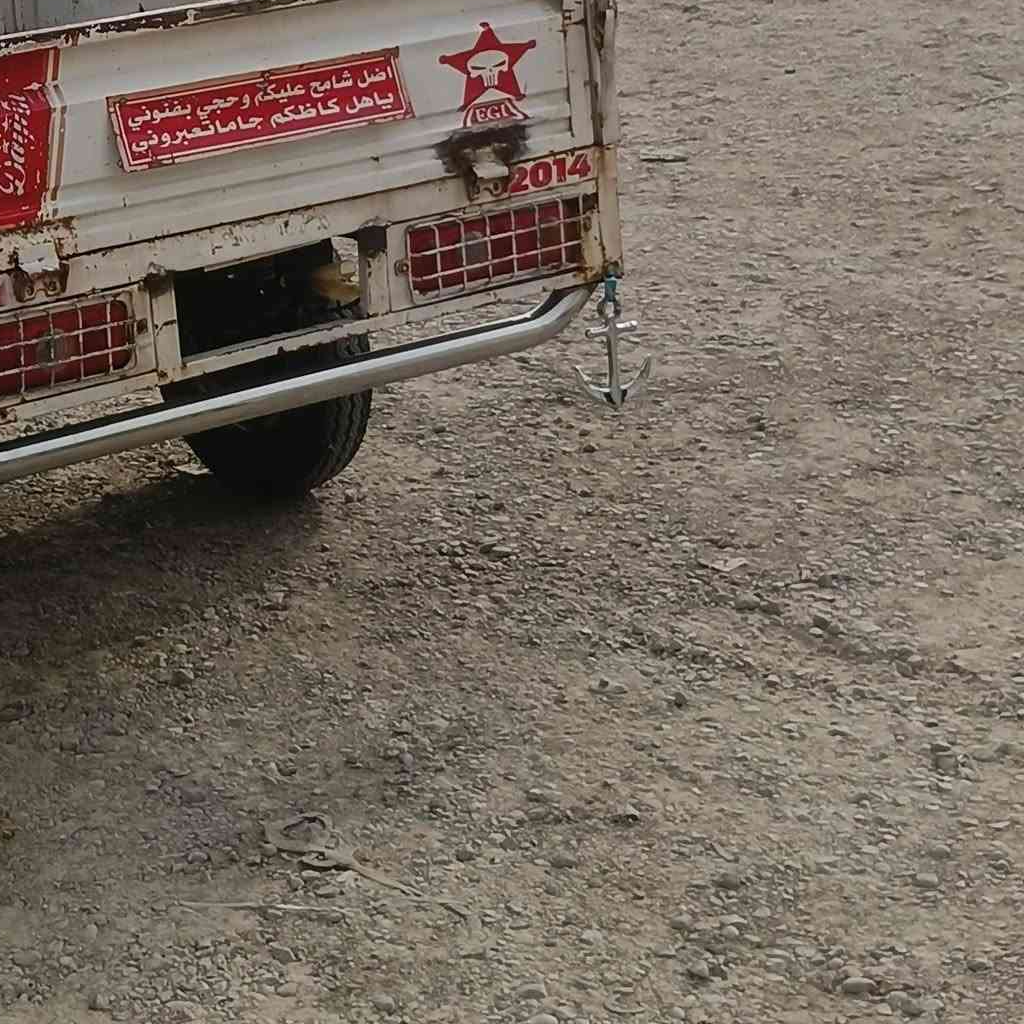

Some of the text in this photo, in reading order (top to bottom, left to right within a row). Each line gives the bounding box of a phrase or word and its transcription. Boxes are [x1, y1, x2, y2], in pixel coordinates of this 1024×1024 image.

[254, 81, 306, 107] عليكم
[127, 103, 192, 131] بفنوني
[508, 152, 592, 194] 2014
